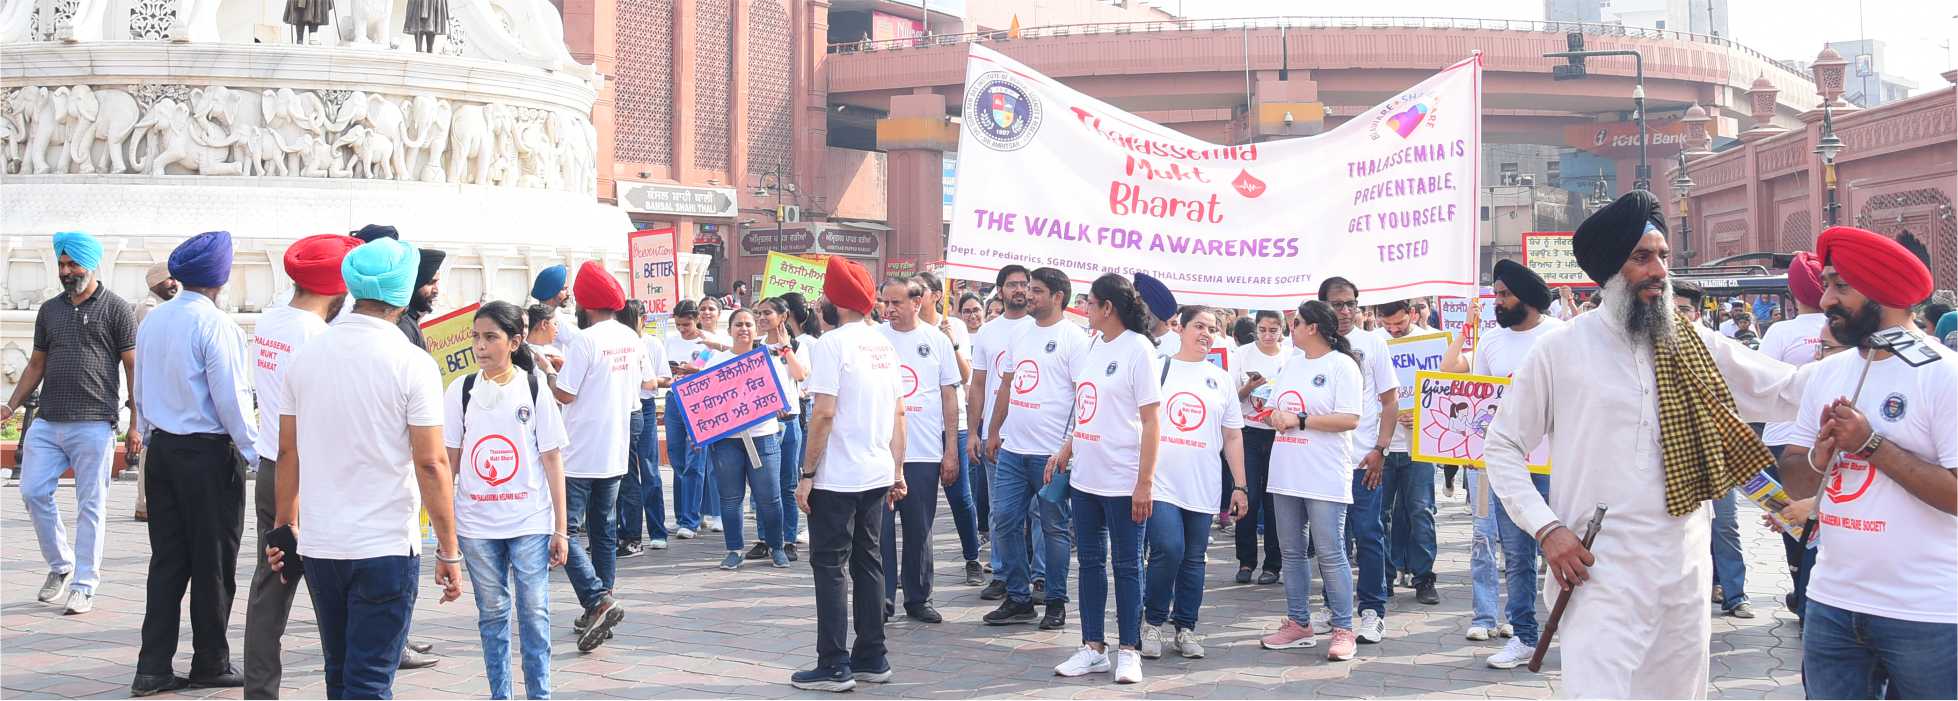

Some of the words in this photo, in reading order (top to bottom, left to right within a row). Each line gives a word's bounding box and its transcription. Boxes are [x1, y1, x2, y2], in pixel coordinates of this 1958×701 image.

[1070, 106, 1257, 161] Thalassemia
[1652, 131, 1687, 145] Bank
[1126, 155, 1211, 183] Mukt
[1347, 143, 1445, 178] THALASSEMIA
[1450, 139, 1465, 157] IS
[1109, 180, 1223, 224] Bharat
[1354, 172, 1456, 206] PREVENTABLE,
[973, 208, 1017, 233] THE
[1024, 215, 1091, 244] WALK
[1097, 227, 1142, 251] FOR
[1149, 233, 1300, 258] AWARENESS
[1348, 214, 1372, 234] GET
[1377, 204, 1457, 230] YOURSELF
[950, 244, 977, 256] Dept.
[980, 248, 990, 257] of
[1047, 257, 1099, 271] SGRDIMSR
[1101, 265, 1121, 274] and
[1153, 270, 1223, 284] THALASSEMIA
[1226, 275, 1272, 285] WELFARE
[1274, 274, 1312, 284] SOCIETY
[1377, 239, 1429, 262] TESTED
[643, 261, 675, 278] BETTER
[647, 282, 663, 295] than
[1421, 378, 1450, 409] Give
[1450, 380, 1495, 400] BLOOD
[732, 402, 750, 418] ਅਤੇ
[1863, 519, 1887, 533] SOCIETY
